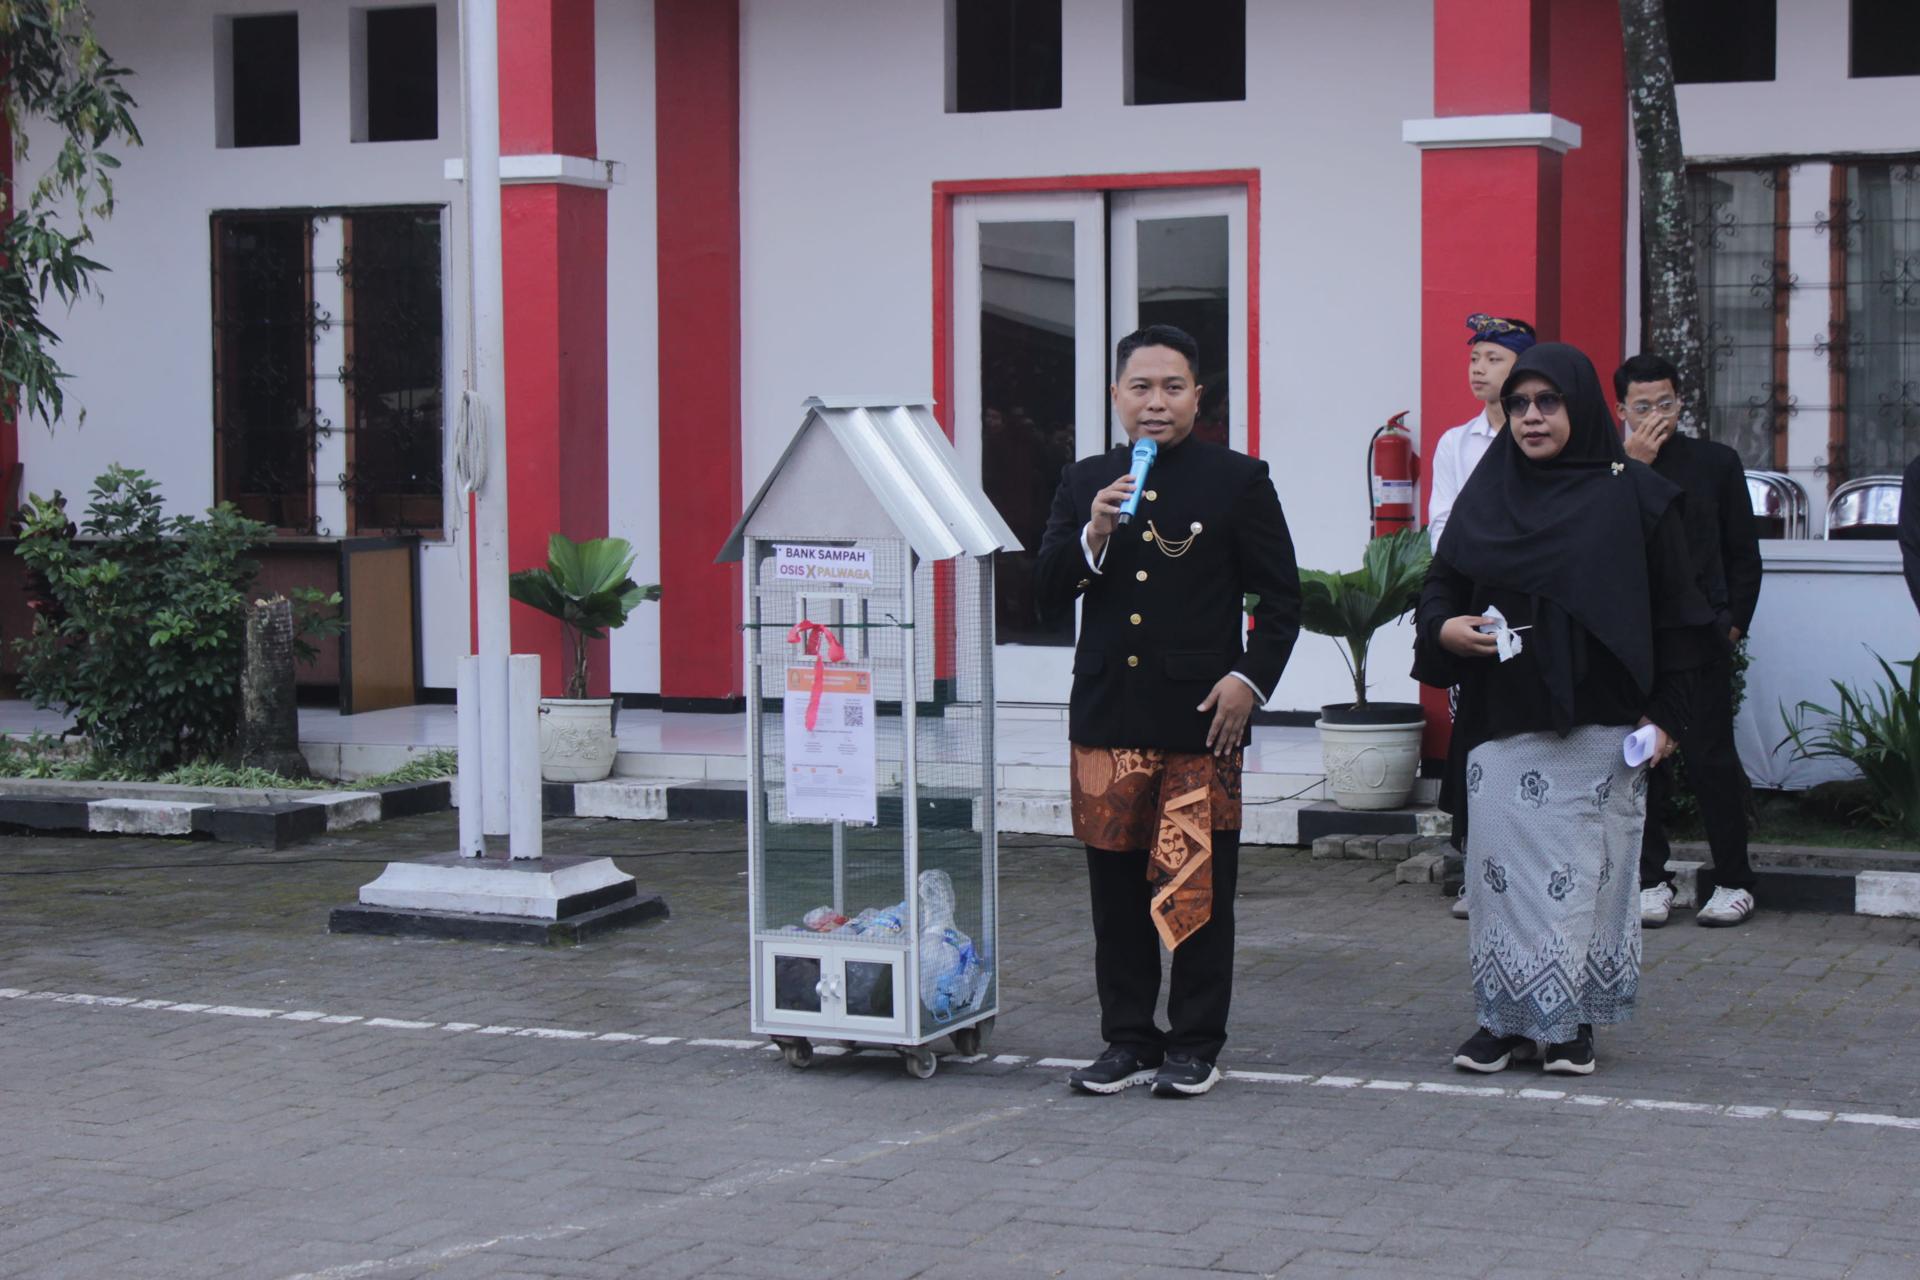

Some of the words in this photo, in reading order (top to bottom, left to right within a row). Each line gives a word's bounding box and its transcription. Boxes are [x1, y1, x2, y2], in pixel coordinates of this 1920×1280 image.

[786, 547, 815, 559] BANK
[818, 549, 865, 562] SAMPAH
[780, 564, 805, 576] OSIS
[817, 566, 872, 580] PALWAGA
